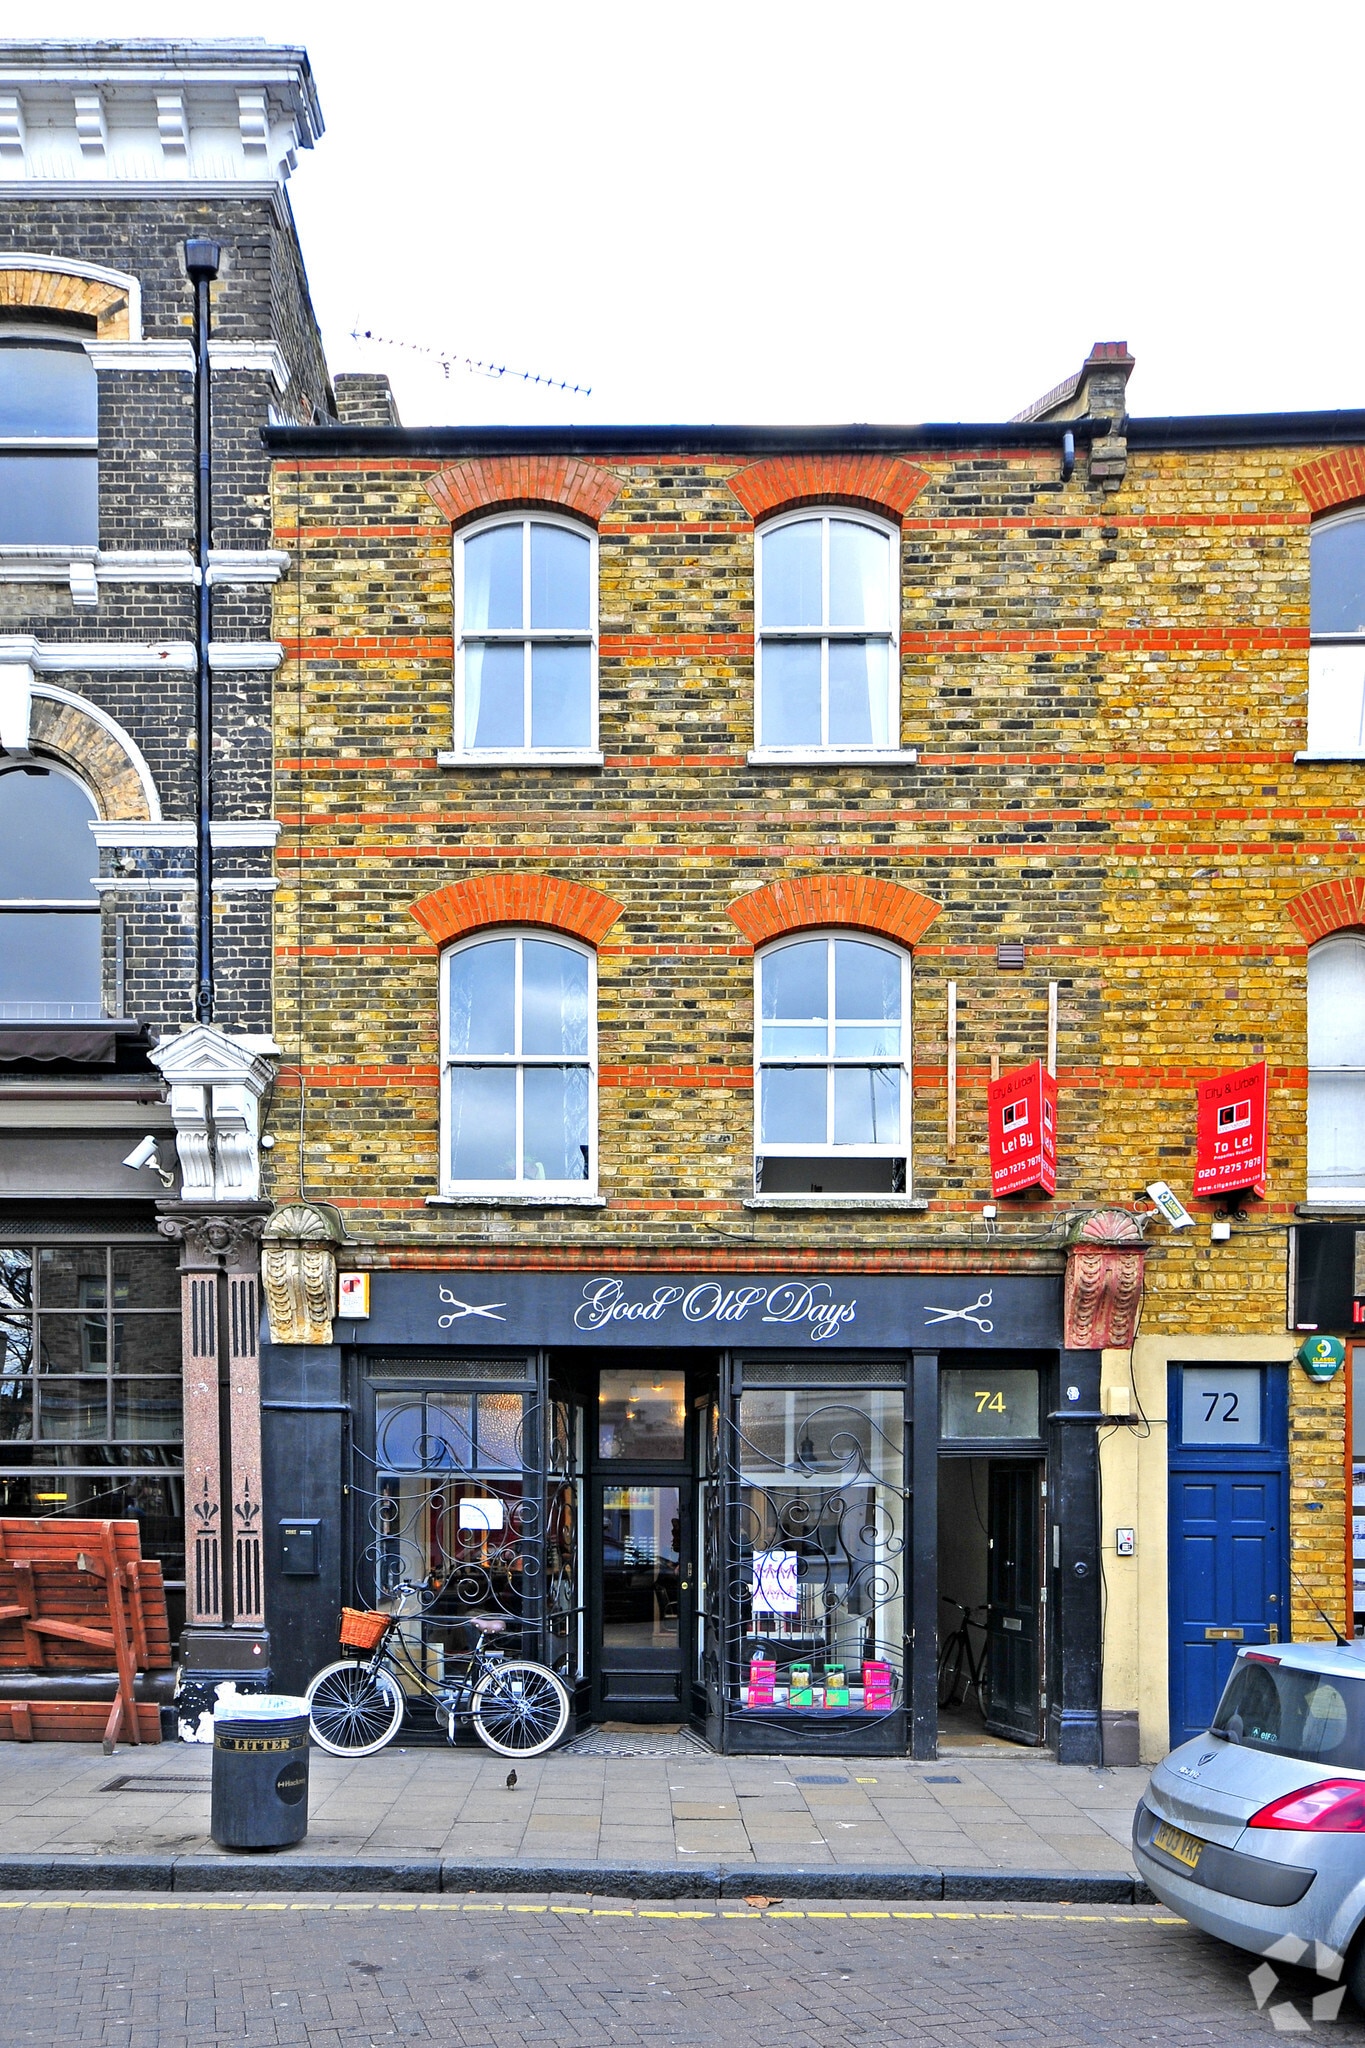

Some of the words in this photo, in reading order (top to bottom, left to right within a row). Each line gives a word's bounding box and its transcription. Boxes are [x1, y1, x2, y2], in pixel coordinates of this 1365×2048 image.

[1007, 1083, 1013, 1093] &
[1014, 1074, 1036, 1090] Urban
[1205, 1087, 1222, 1099] City
[1225, 1083, 1231, 1093] &
[1234, 1075, 1259, 1091] Urban
[1002, 1136, 1017, 1154] Let
[1019, 1133, 1033, 1147] By
[1214, 1142, 1228, 1154] To
[1234, 1133, 1253, 1149] Let
[994, 1168, 1008, 1179] 020
[1009, 1161, 1026, 1174] 7275
[1198, 1168, 1216, 1178] 020
[1219, 1162, 1241, 1175] 7275
[573, 1277, 684, 1330] Good
[682, 1282, 767, 1322] Old
[762, 1282, 856, 1341] Days
[974, 1391, 1006, 1413] 74
[1202, 1392, 1240, 1422] 72
[234, 1739, 290, 1751] LITTER
